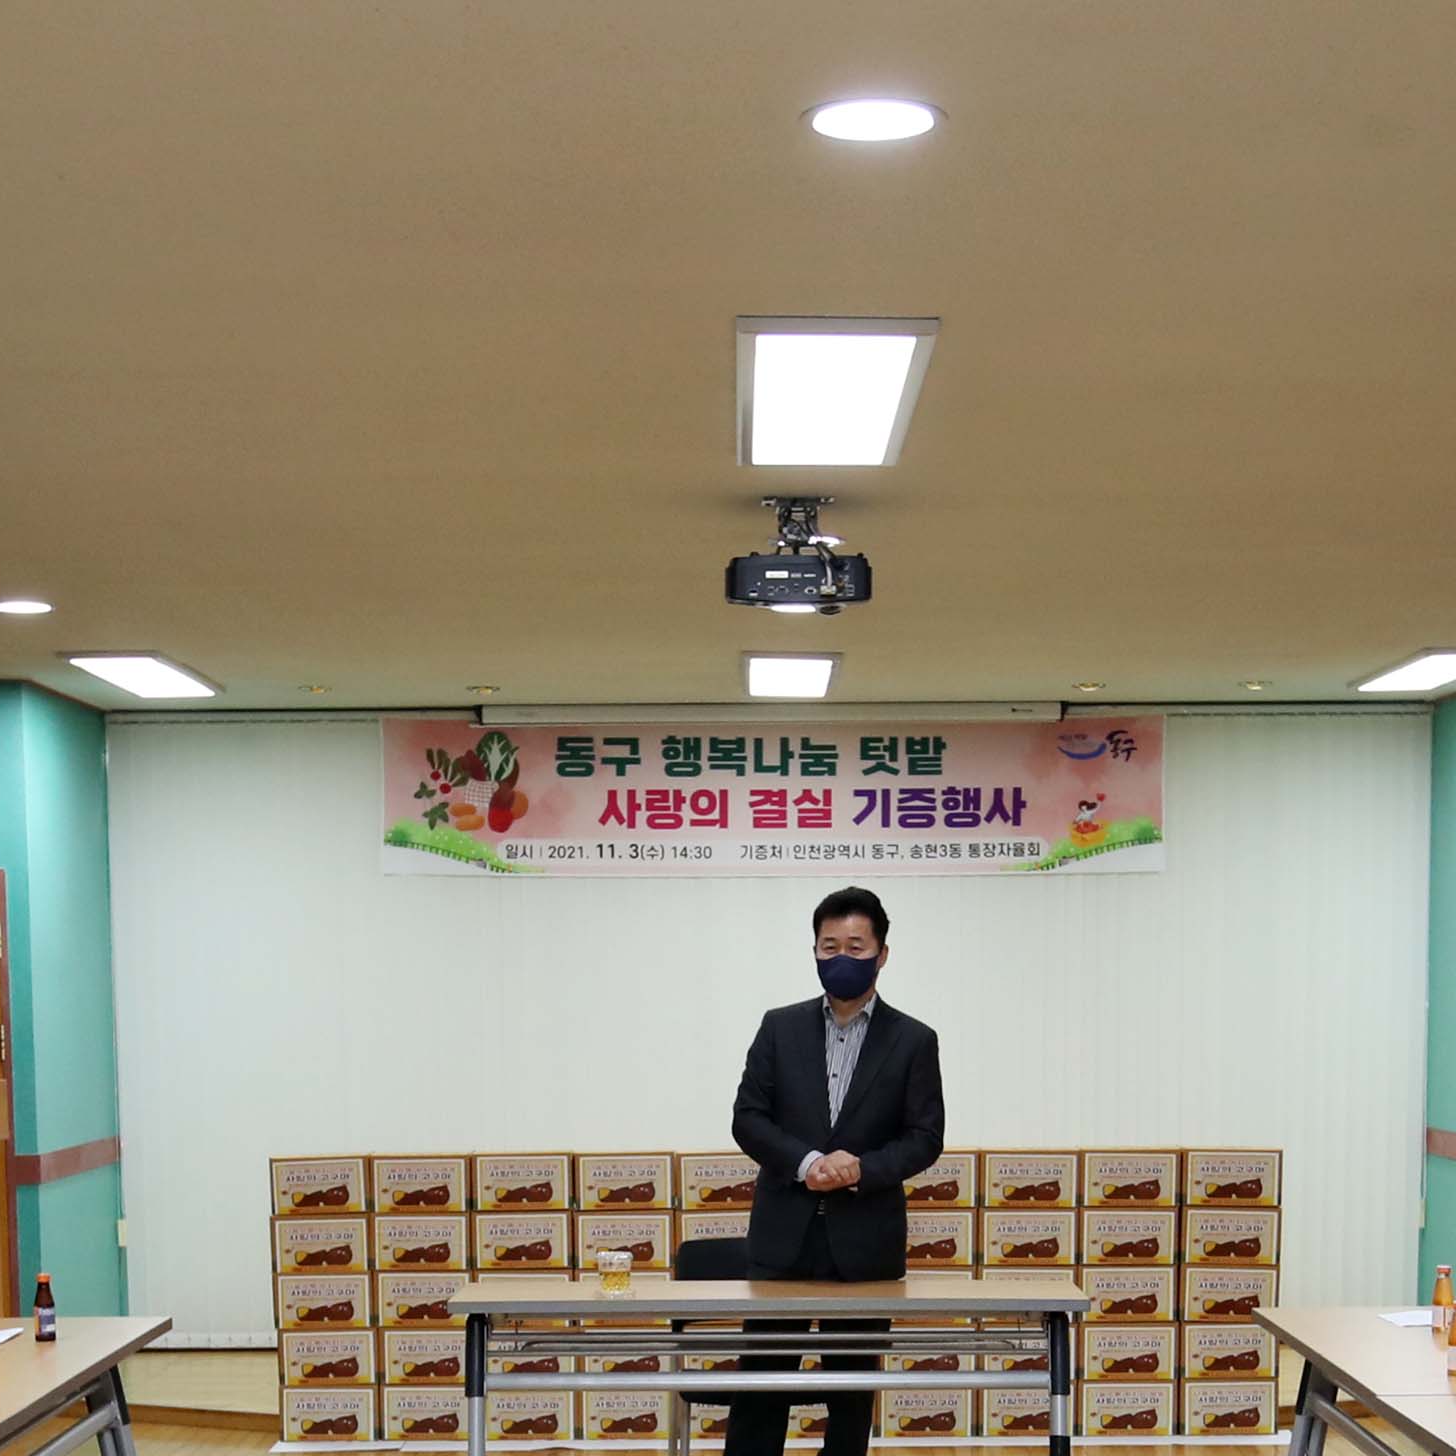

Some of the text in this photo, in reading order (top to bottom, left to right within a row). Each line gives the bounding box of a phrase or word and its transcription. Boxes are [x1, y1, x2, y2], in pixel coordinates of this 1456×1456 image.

[553, 734, 948, 778] 동구 행복나눔 텃밭
[597, 785, 1029, 830] 사랑의 결실 기증행사
[505, 843, 713, 861] 일시 2021. 11. 3(수) 14:30
[739, 842, 1041, 860] 기증처 인천광역시 동구, 송현3동 통장자율회
